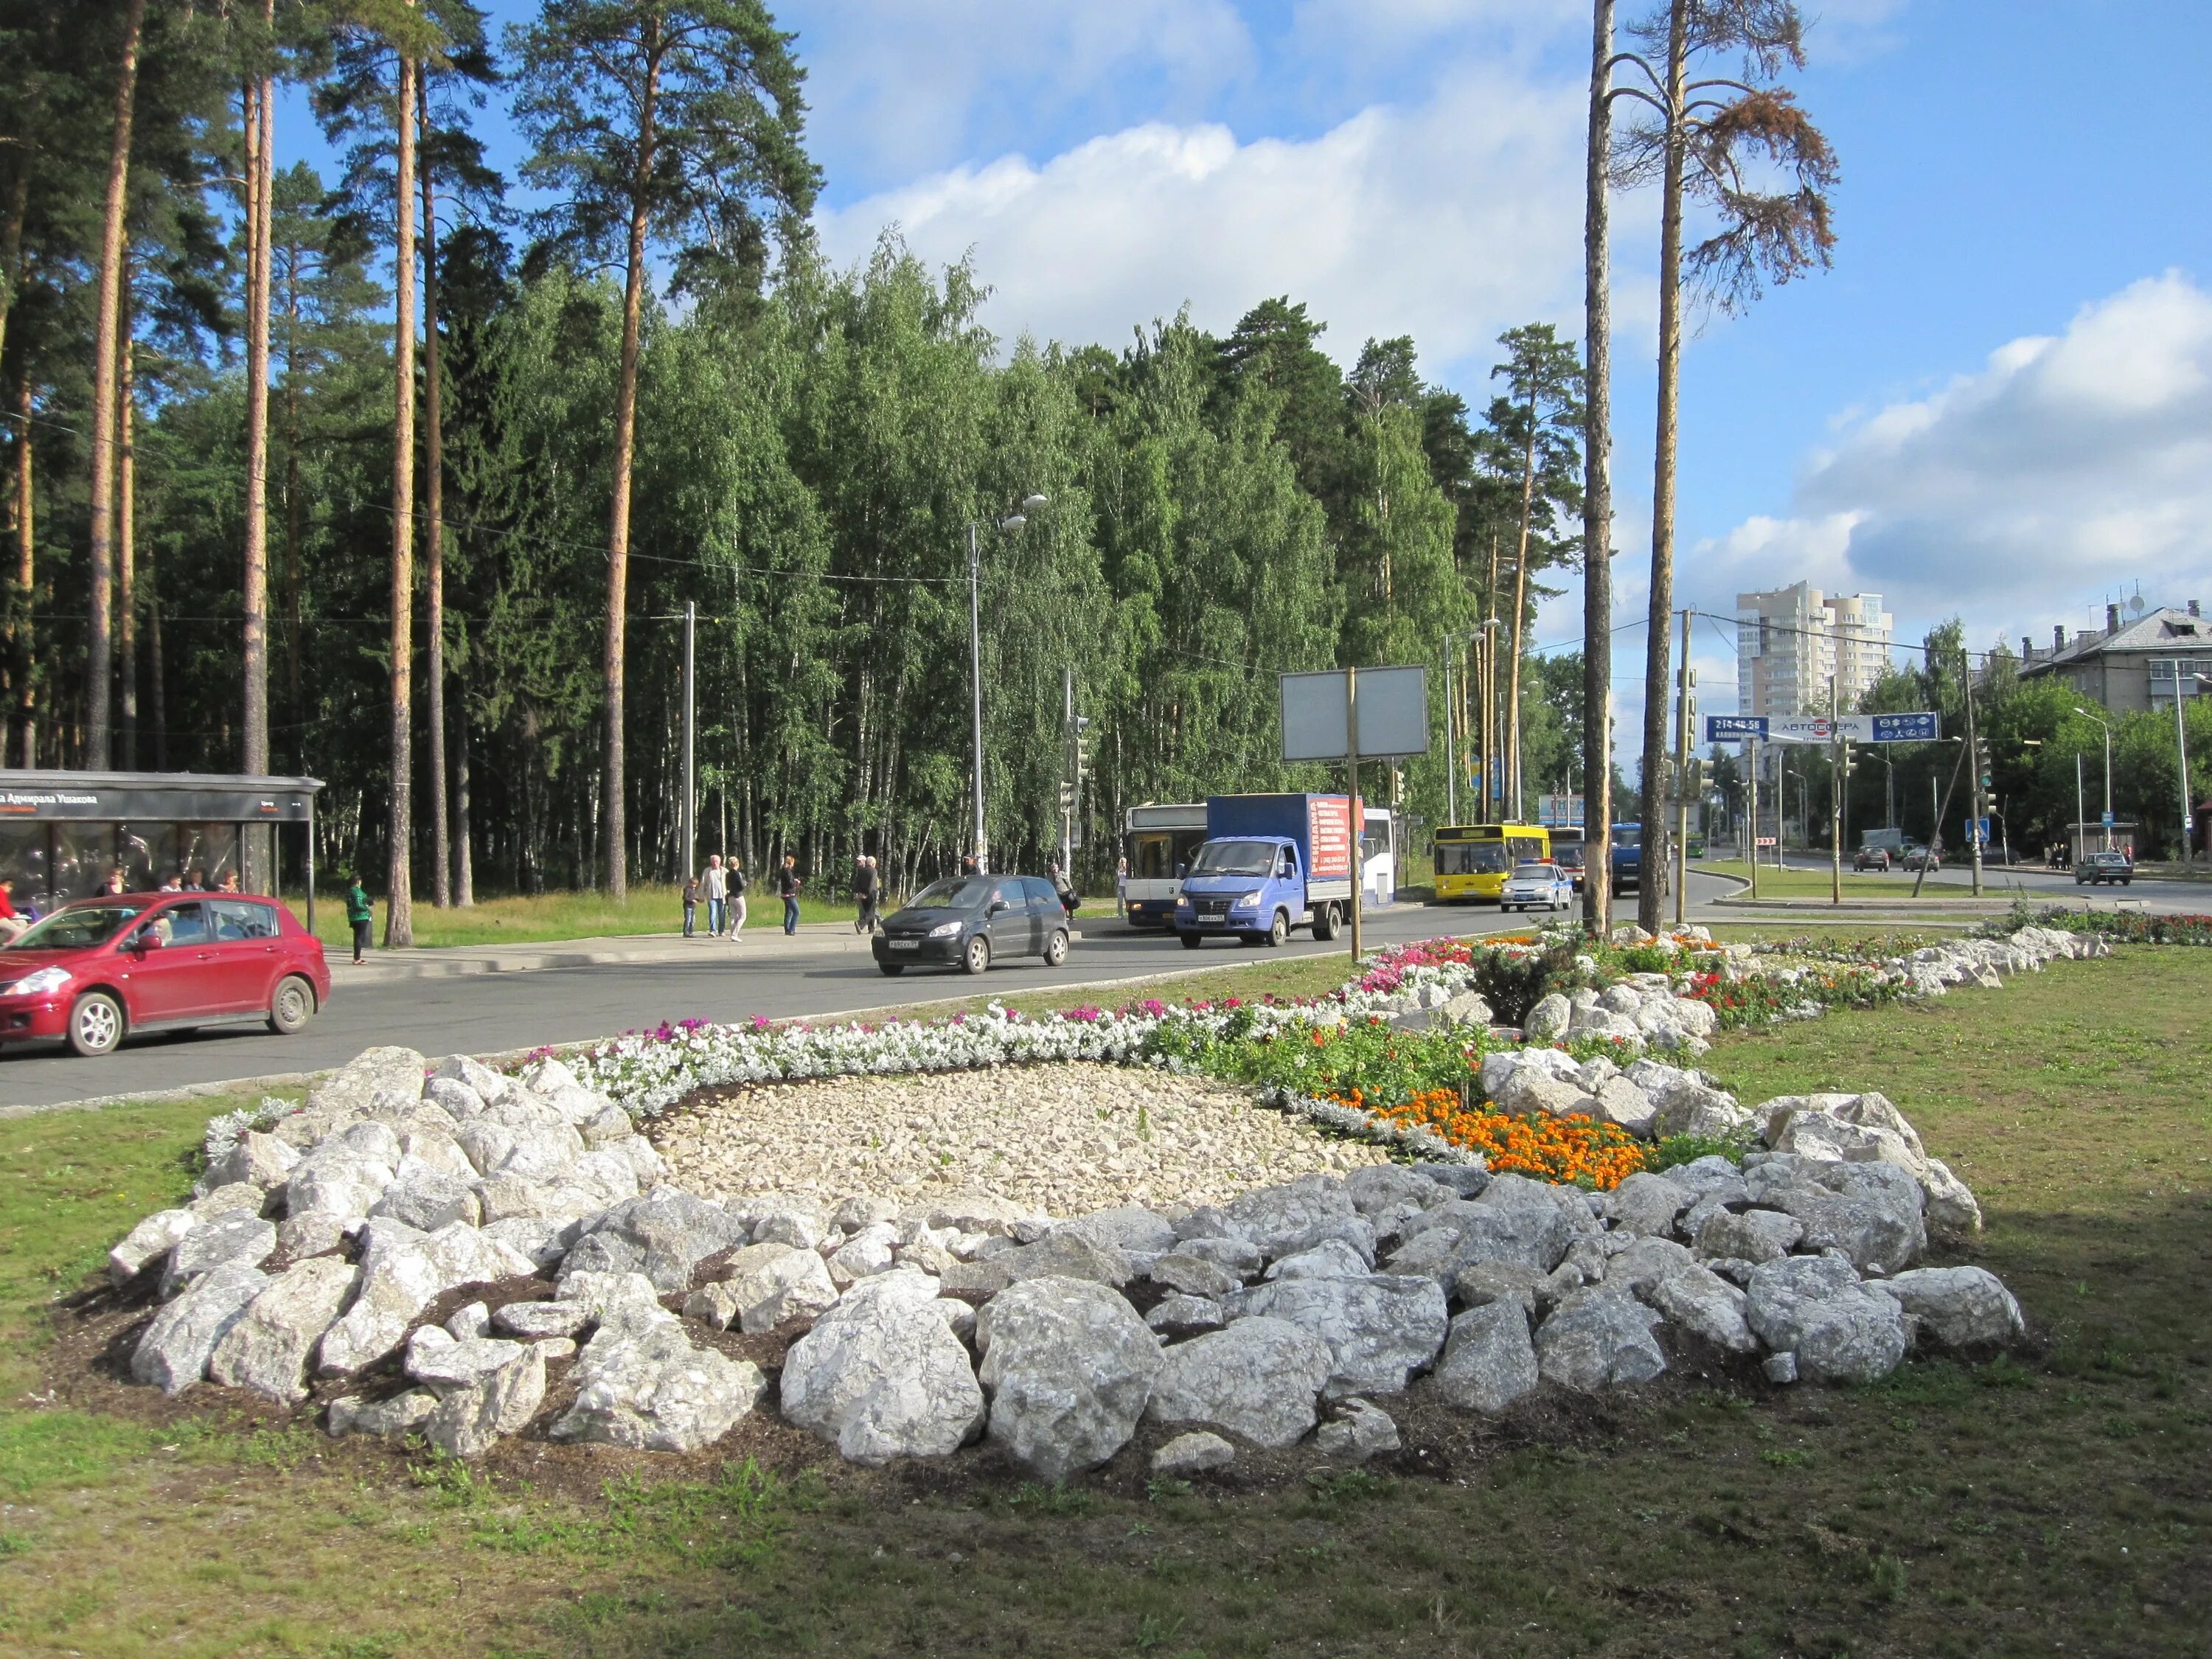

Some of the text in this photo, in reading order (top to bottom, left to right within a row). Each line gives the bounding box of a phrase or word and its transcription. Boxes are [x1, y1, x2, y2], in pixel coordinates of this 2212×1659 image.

[7, 793, 57, 806] Адмирала
[57, 793, 98, 804] Ушакова
[1310, 801, 1319, 873] РЕКЛАМА
